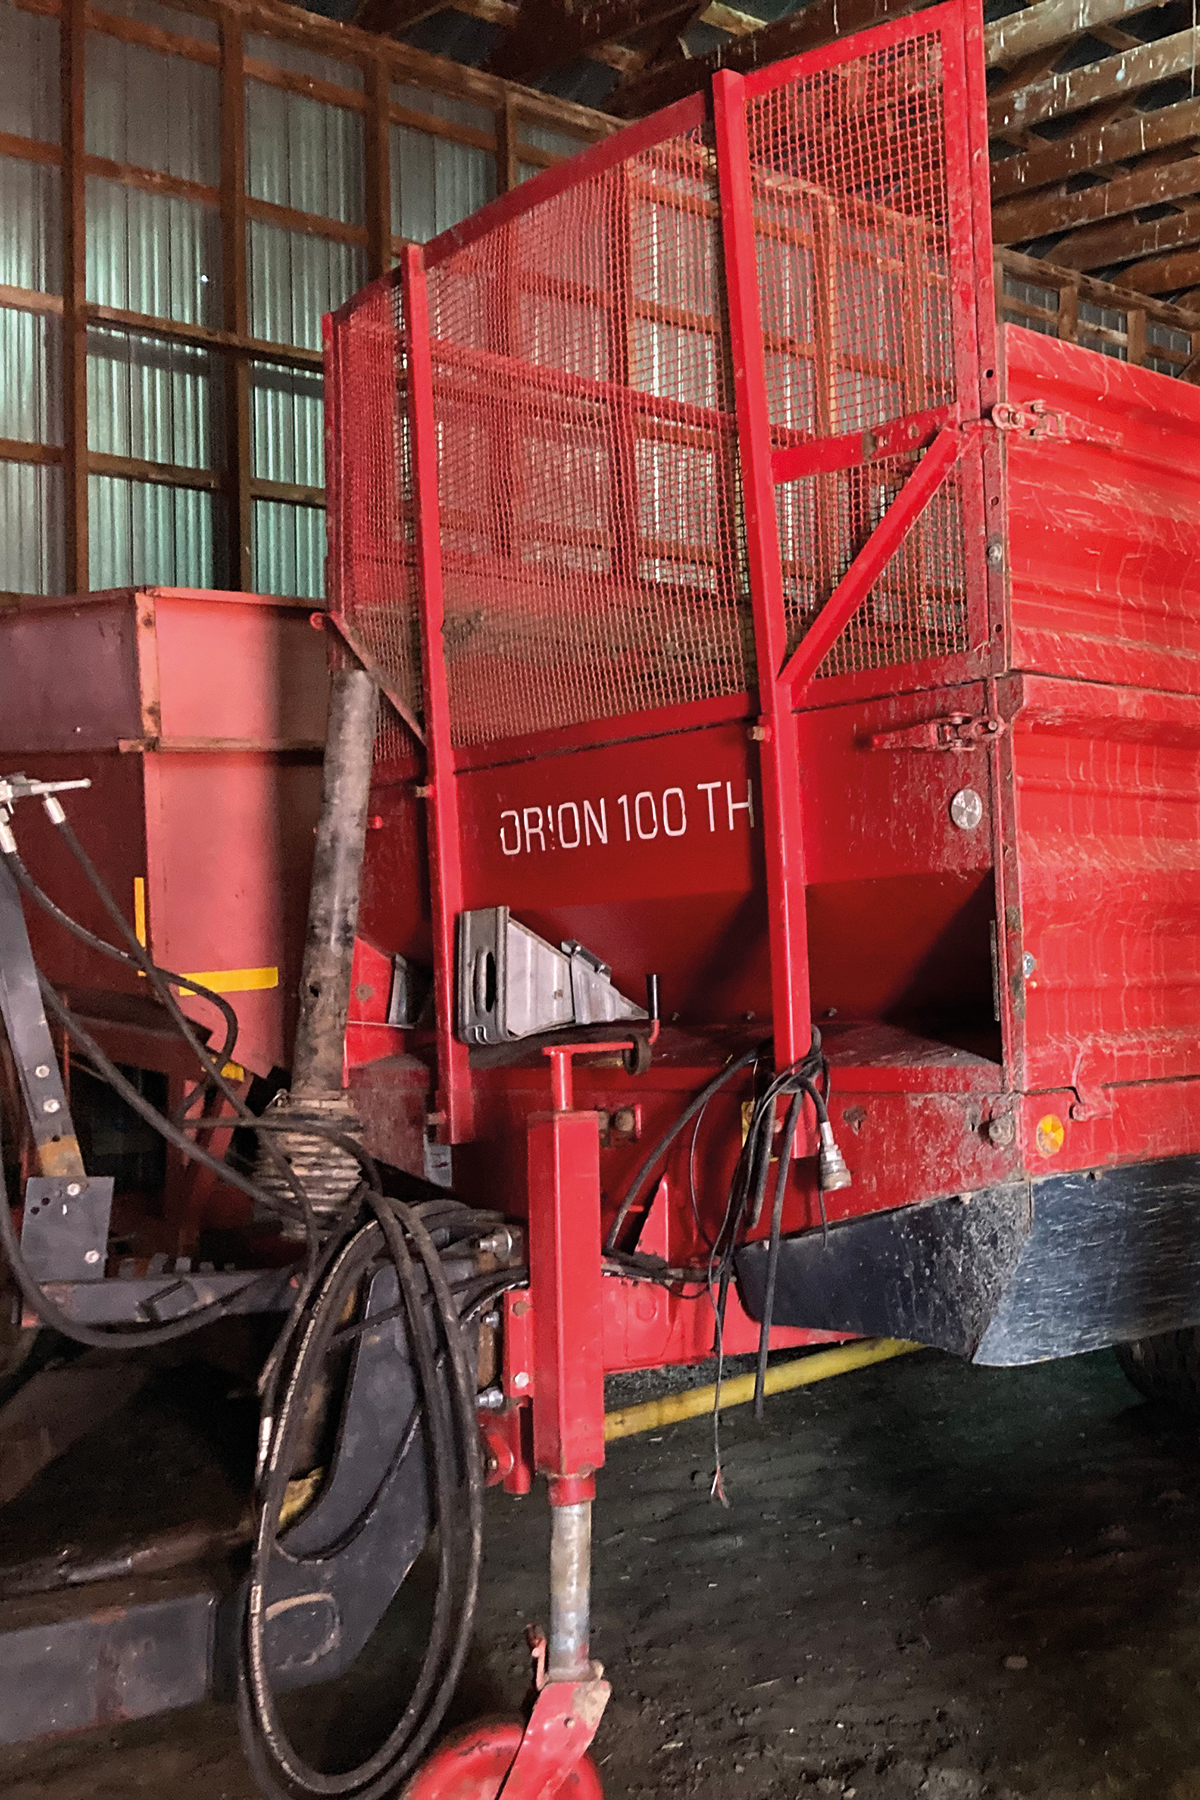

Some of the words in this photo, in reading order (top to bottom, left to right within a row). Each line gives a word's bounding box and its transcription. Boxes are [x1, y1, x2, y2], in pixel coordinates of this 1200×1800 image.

[500, 797, 608, 855] ORION
[617, 787, 687, 842] 100
[696, 779, 755, 833] TH
